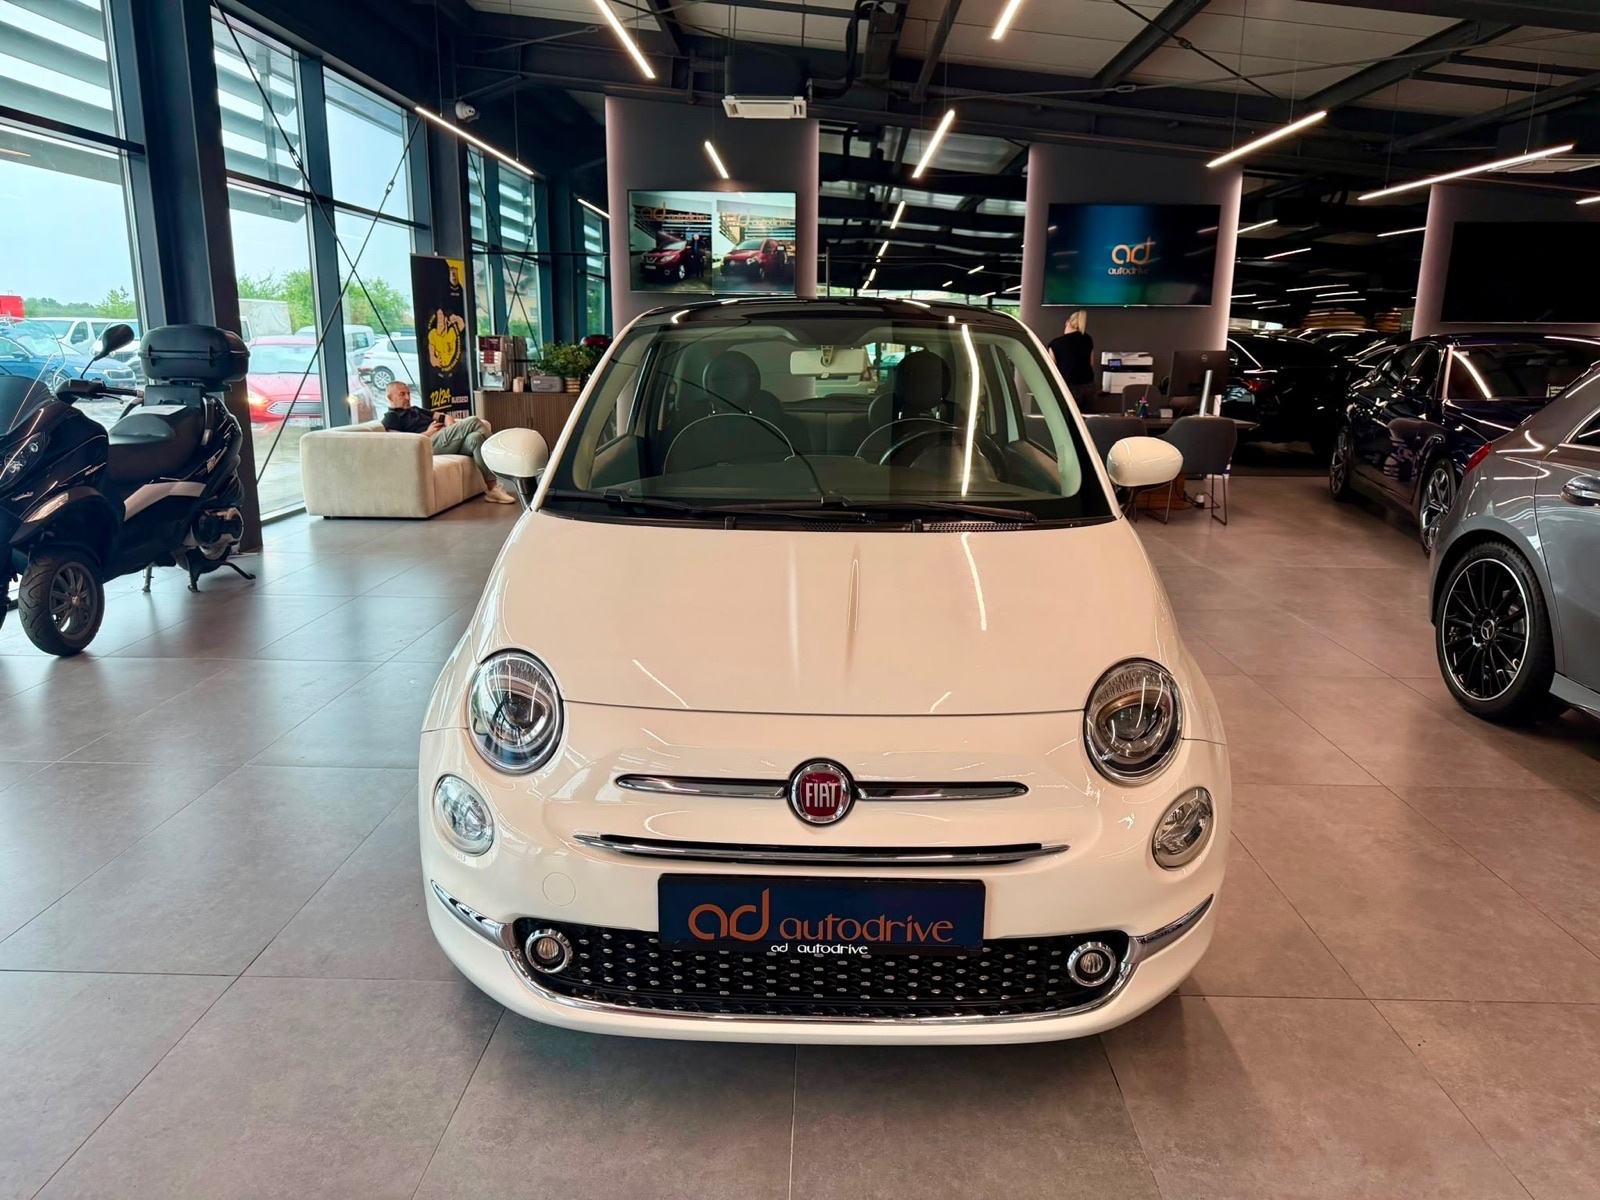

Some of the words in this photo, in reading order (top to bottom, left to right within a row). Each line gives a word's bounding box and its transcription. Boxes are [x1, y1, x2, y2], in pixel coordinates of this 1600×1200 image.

[1111, 235, 1152, 265] ad
[805, 782, 838, 808] FIAT
[687, 887, 770, 942] ad
[779, 912, 954, 943] autodrive
[770, 943, 789, 953] ad
[797, 943, 869, 954] autodrive
